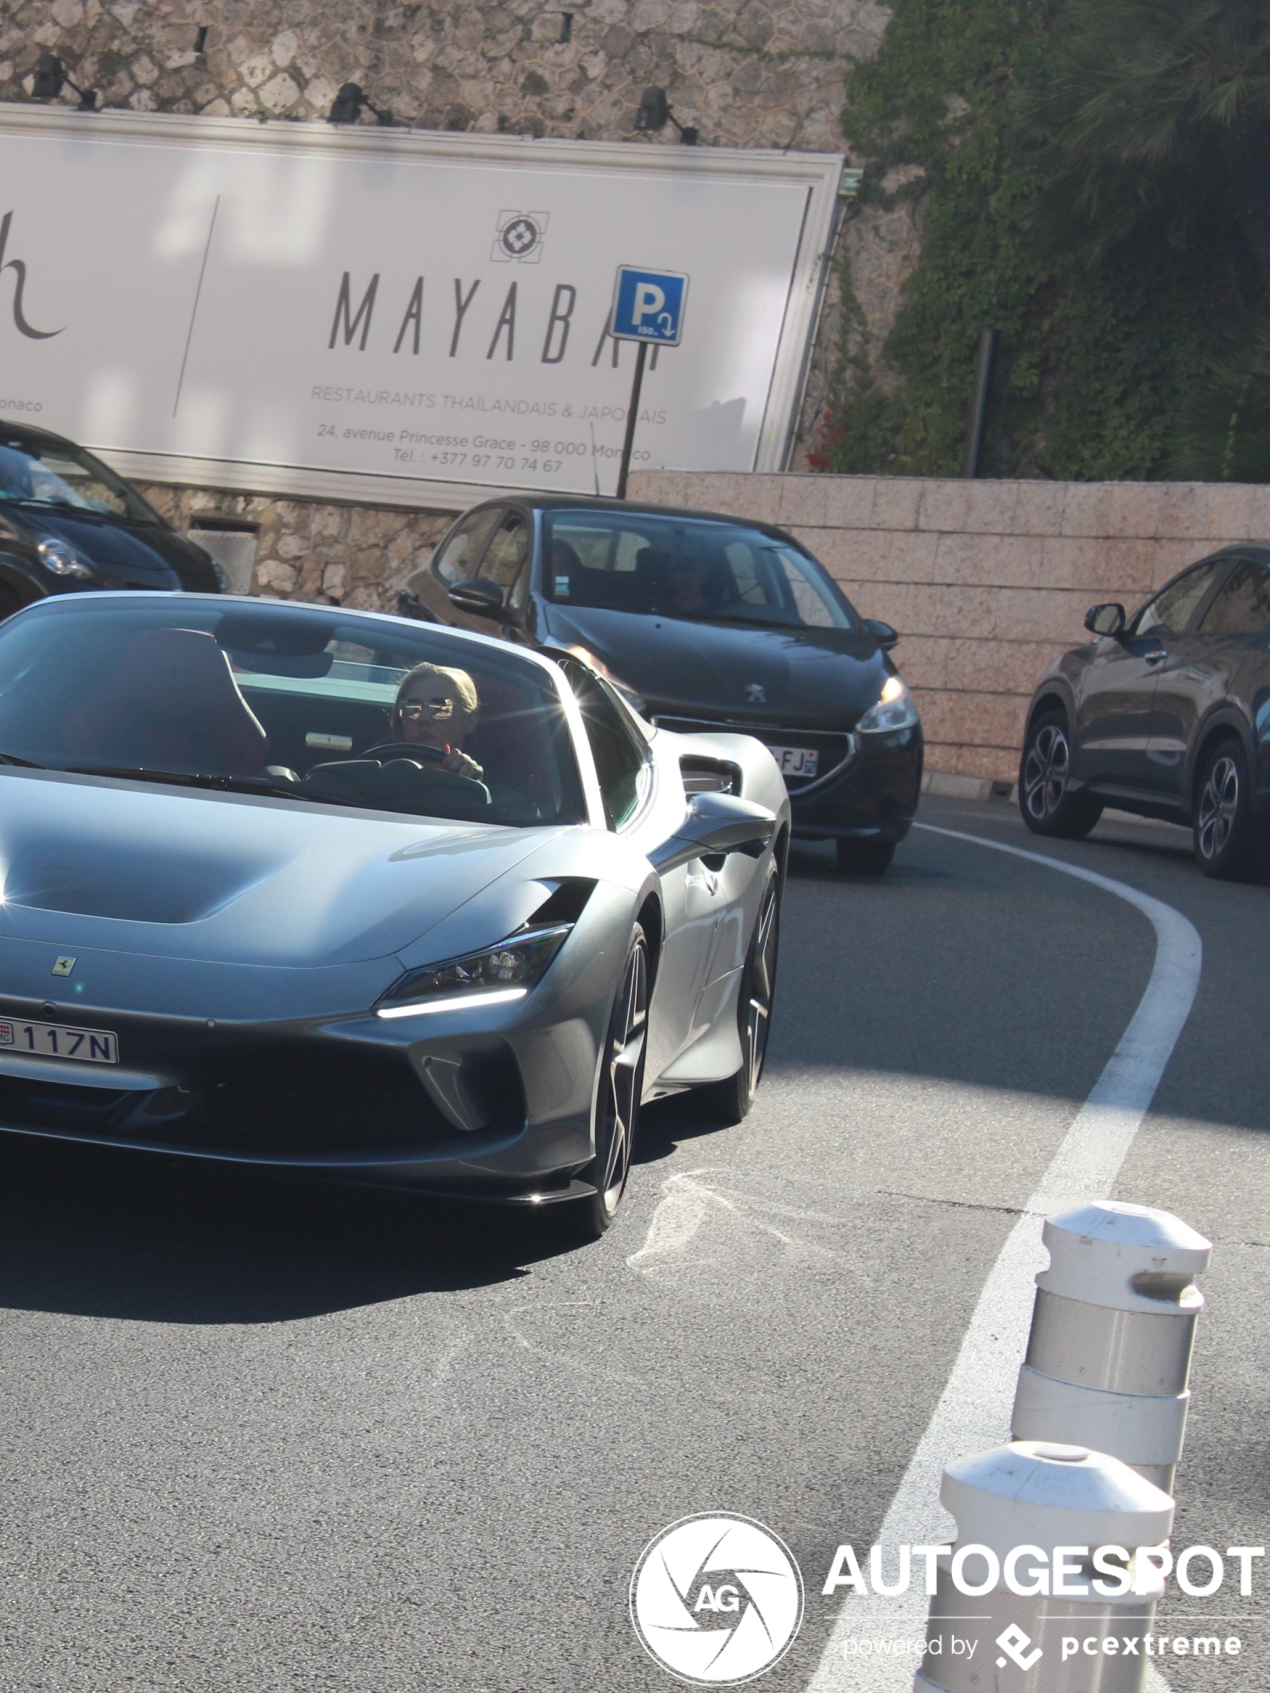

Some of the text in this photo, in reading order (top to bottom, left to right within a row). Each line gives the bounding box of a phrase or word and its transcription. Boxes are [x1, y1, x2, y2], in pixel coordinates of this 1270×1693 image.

[631, 282, 666, 326] P
[311, 386, 668, 424] RESTAURANTS THAÏLANDAIS & JAPOAIS
[317, 424, 339, 438] 24,
[342, 428, 395, 442] avenue
[399, 430, 468, 447] Princesse
[473, 435, 516, 450] Grace
[530, 440, 550, 453] 98
[554, 441, 587, 456] 000
[591, 445, 651, 462] Monco
[393, 448, 416, 463] Tél.
[430, 452, 467, 466] +377
[472, 455, 491, 467] 97
[495, 456, 515, 470] 70
[520, 459, 538, 472] 74
[542, 460, 562, 473] 67
[24, 1026, 111, 1060] 117N
